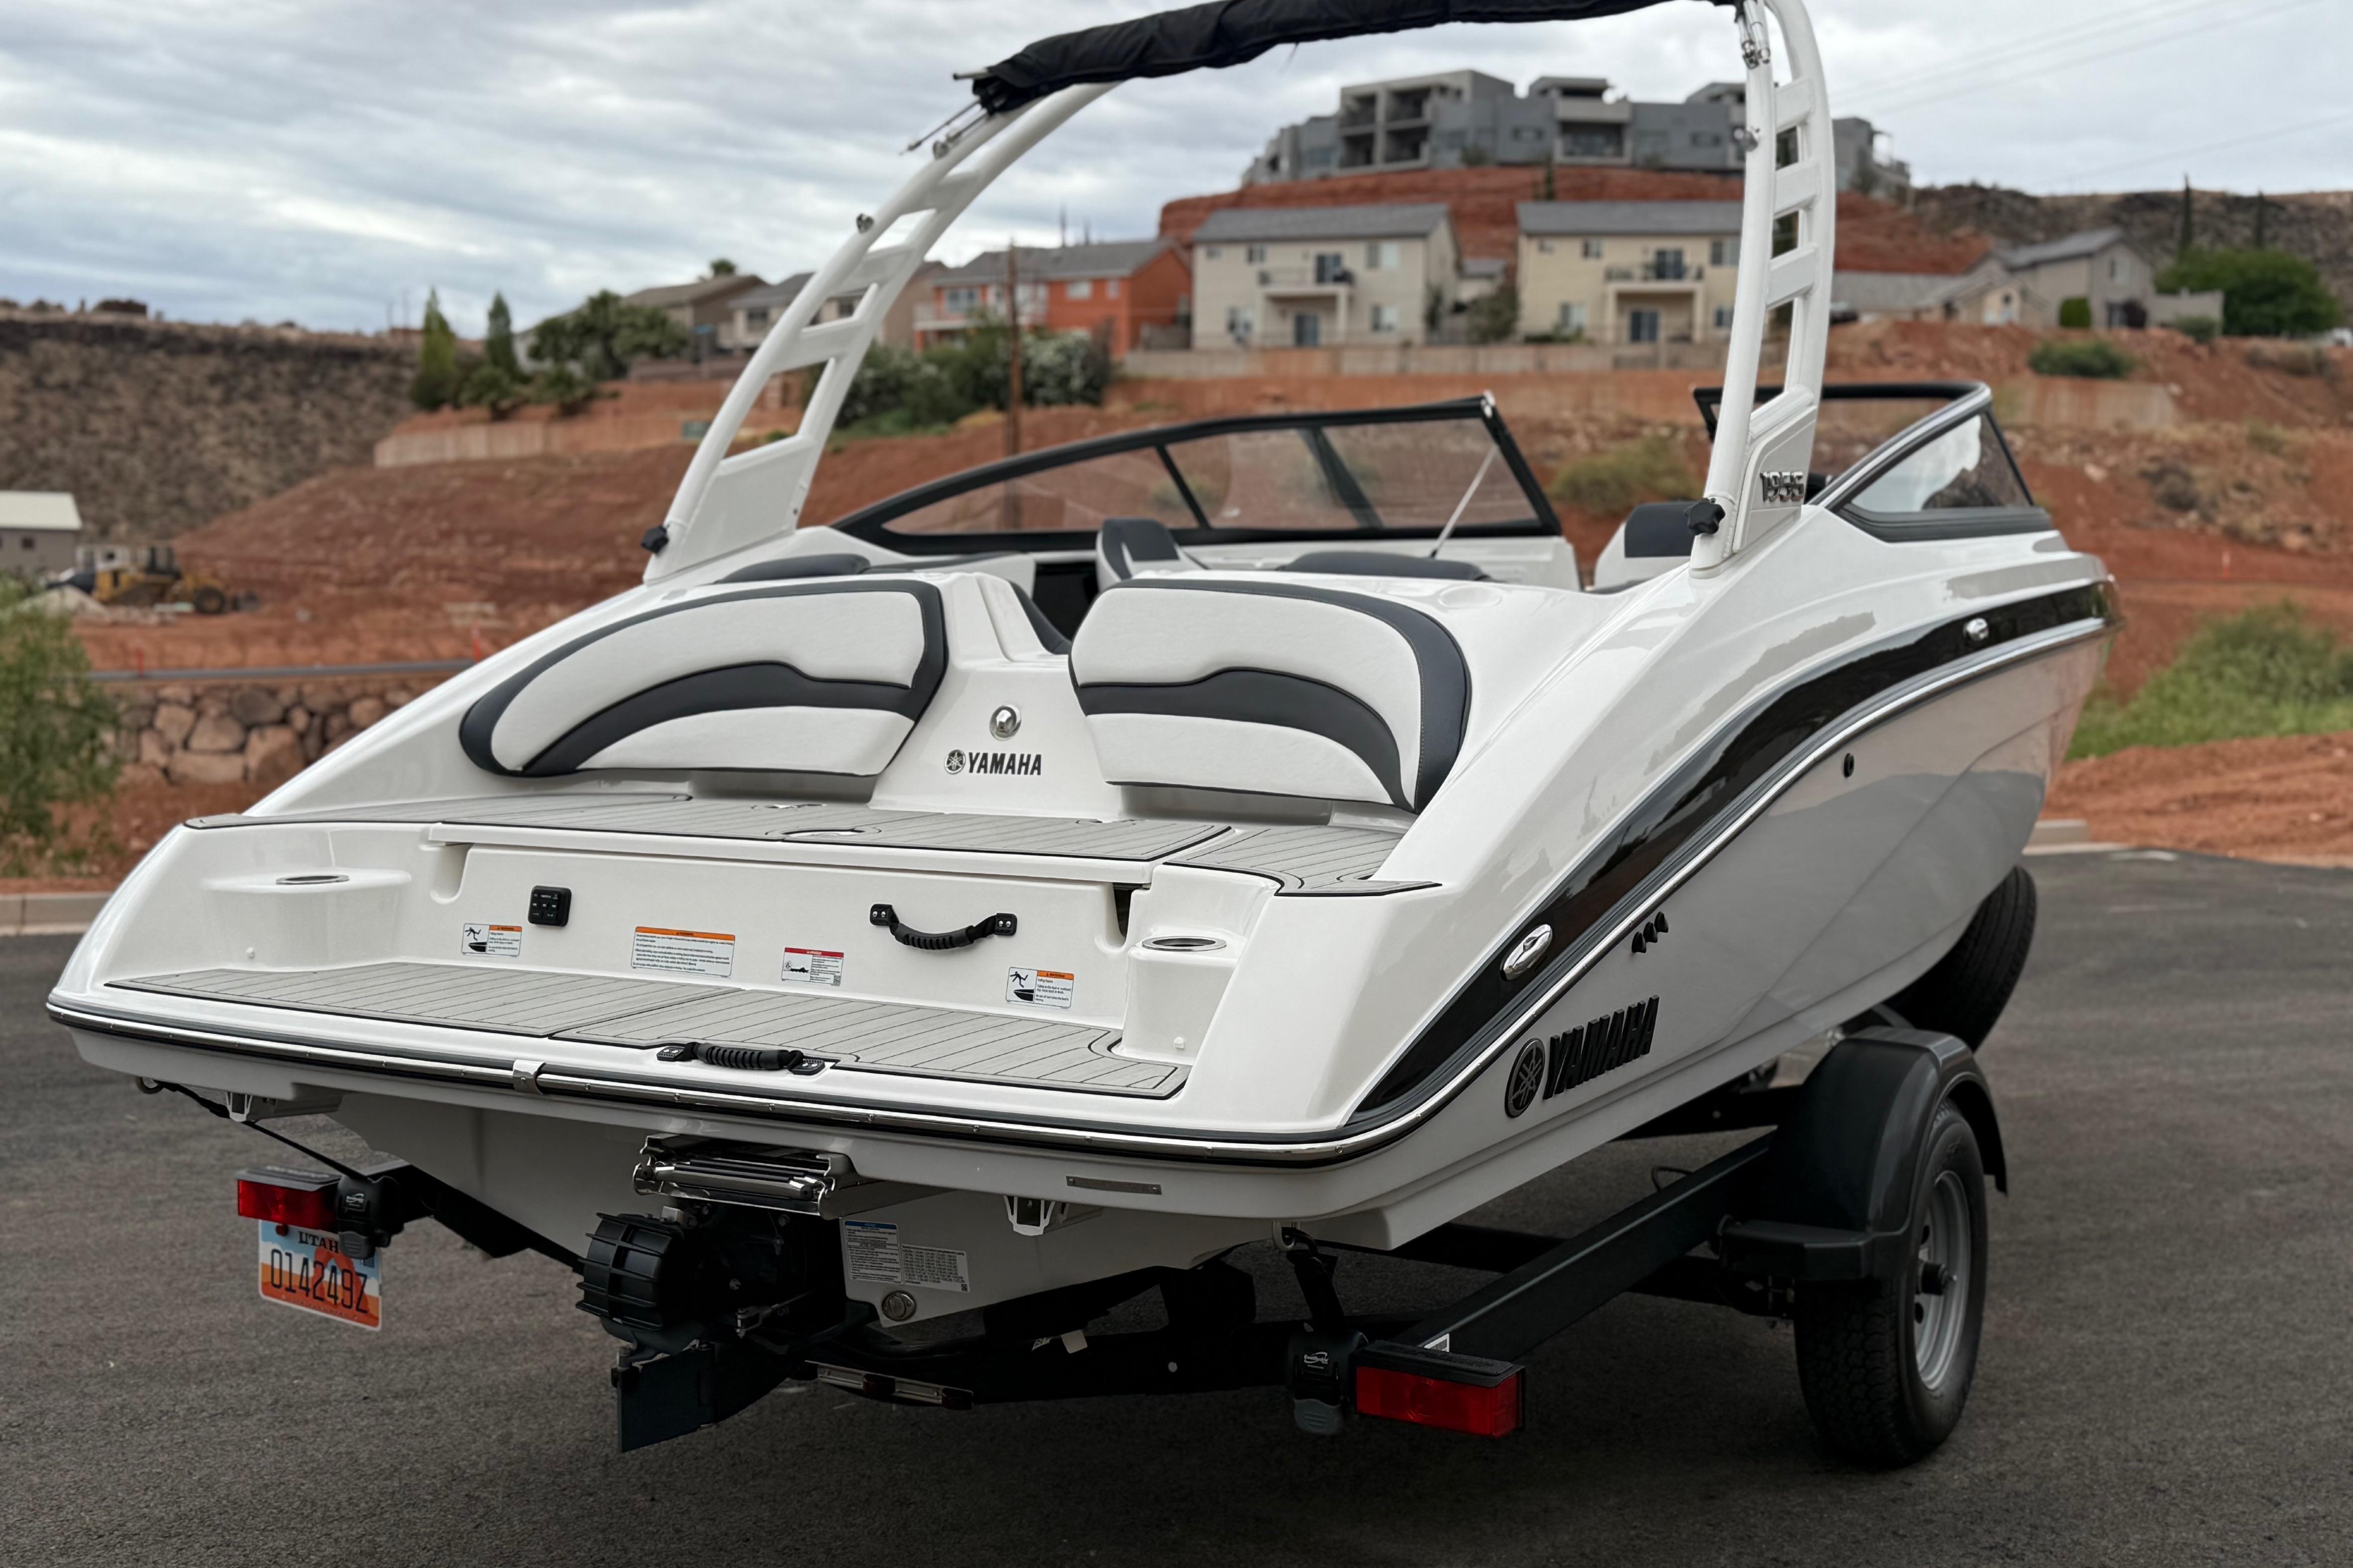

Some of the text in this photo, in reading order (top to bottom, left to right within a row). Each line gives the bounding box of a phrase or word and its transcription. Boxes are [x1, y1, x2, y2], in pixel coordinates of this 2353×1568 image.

[969, 752, 1041, 776] YAMAHA
[1543, 995, 1659, 1099] YAMAHA
[298, 1231, 339, 1254] UTAH
[271, 1249, 368, 1314] 014249Z
